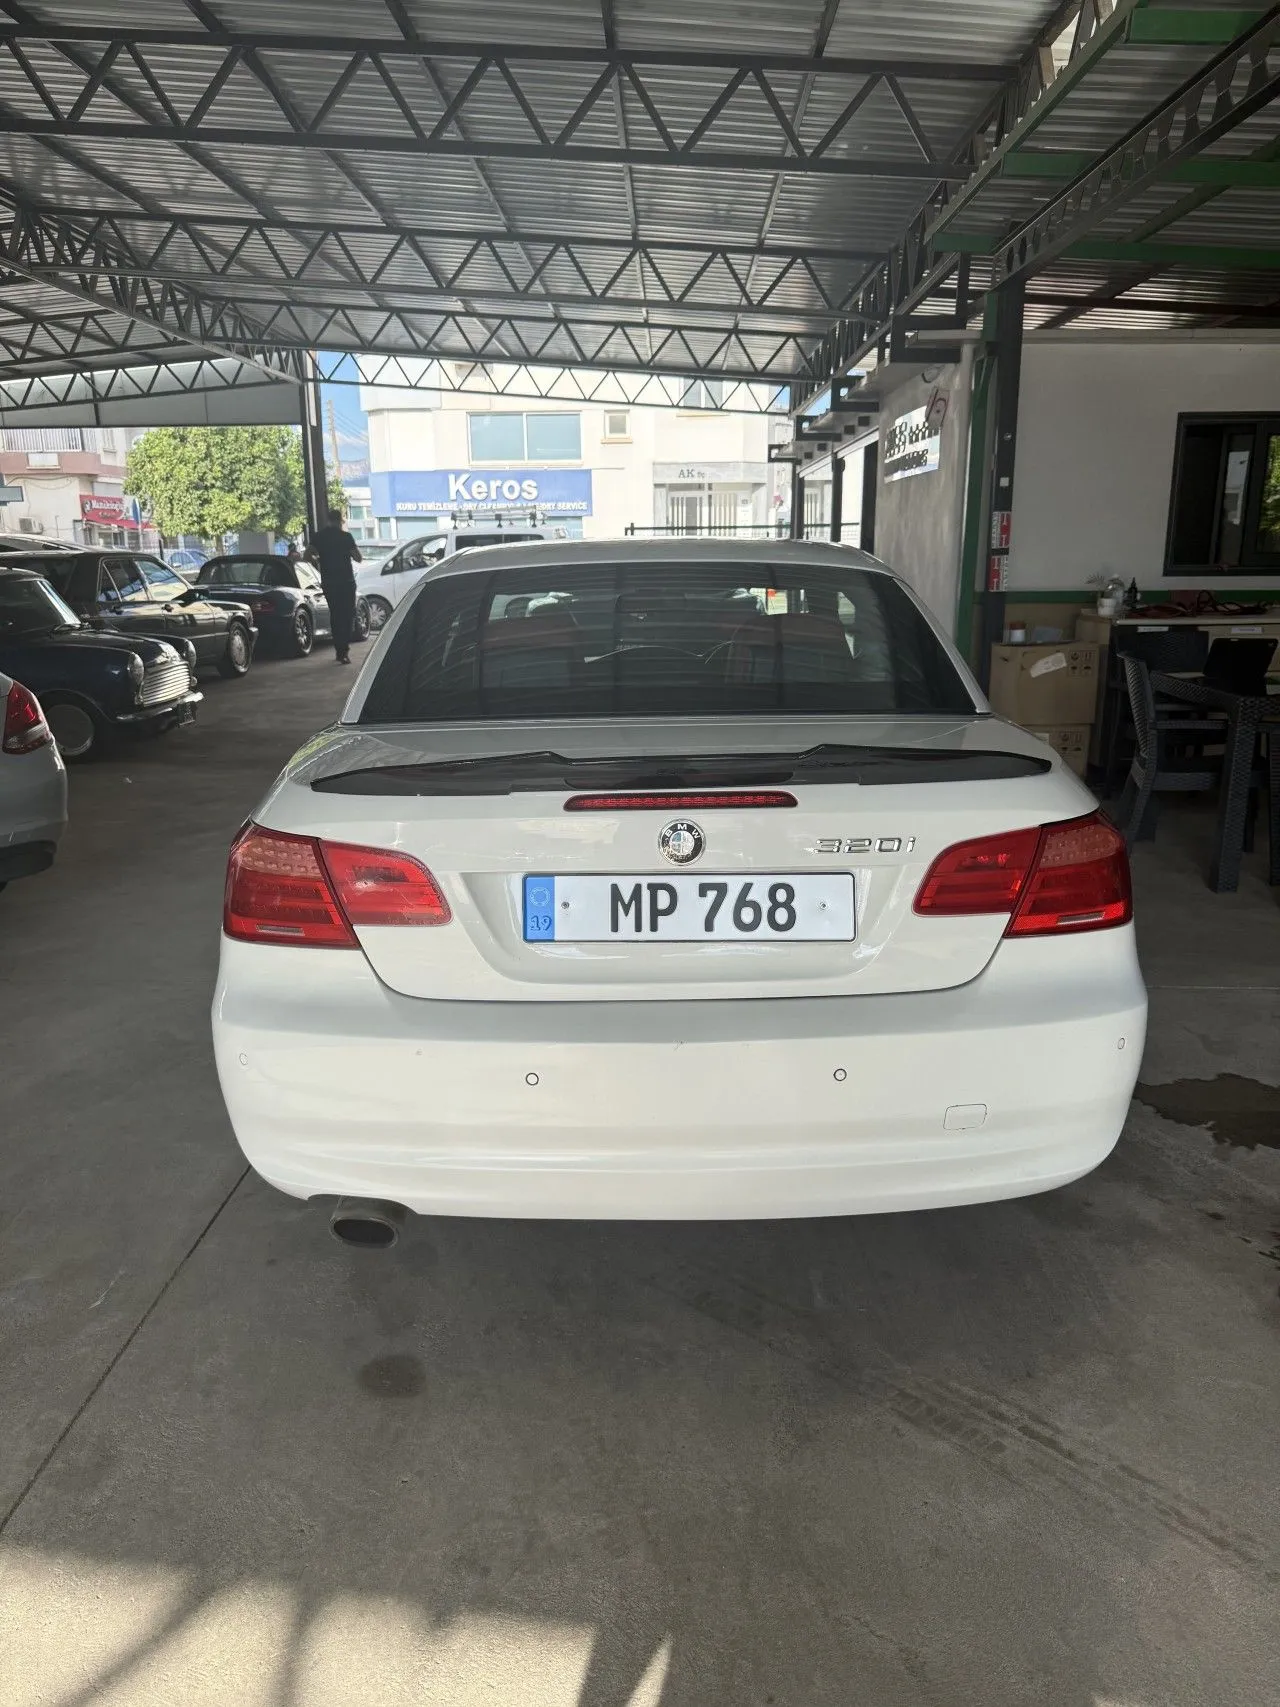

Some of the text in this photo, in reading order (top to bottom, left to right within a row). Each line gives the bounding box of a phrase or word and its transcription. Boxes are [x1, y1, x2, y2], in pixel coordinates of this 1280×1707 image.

[678, 469, 695, 478] AK
[448, 473, 538, 501] Keros
[396, 502, 417, 511] KURU
[463, 502, 477, 511] DRY
[557, 502, 587, 511] SERVICE
[664, 823, 701, 839] BMW
[814, 836, 916, 853] 320i
[610, 882, 797, 933] MP 768
[530, 915, 552, 931] 19
